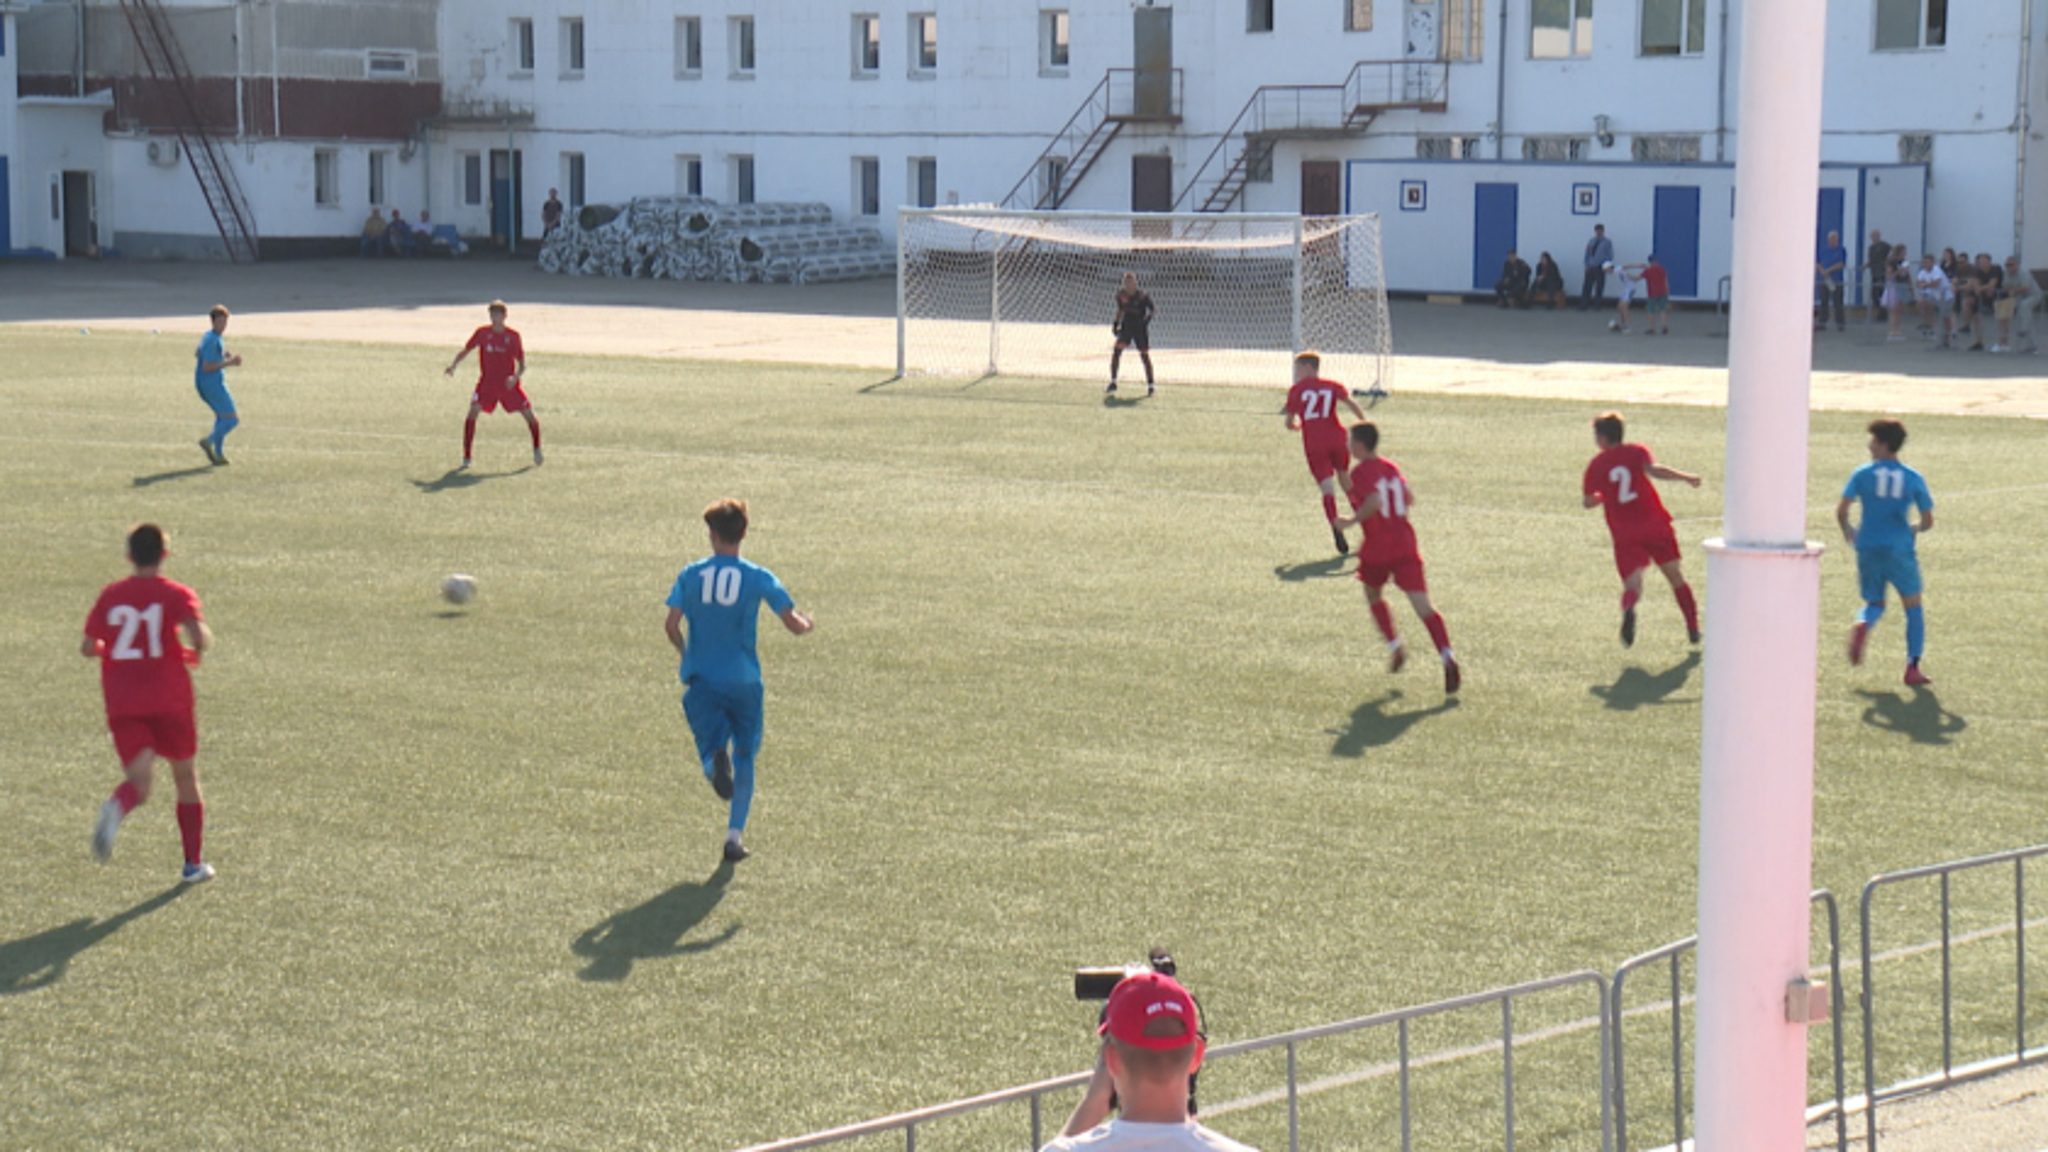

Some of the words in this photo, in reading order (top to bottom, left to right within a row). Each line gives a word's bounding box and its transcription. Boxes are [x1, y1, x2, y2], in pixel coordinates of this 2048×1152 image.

[1302, 389, 1332, 420] 27
[1375, 477, 1406, 518] 11
[1609, 466, 1639, 503] 2
[1874, 467, 1904, 498] 11
[699, 565, 741, 605] 10
[108, 604, 163, 660] 21
